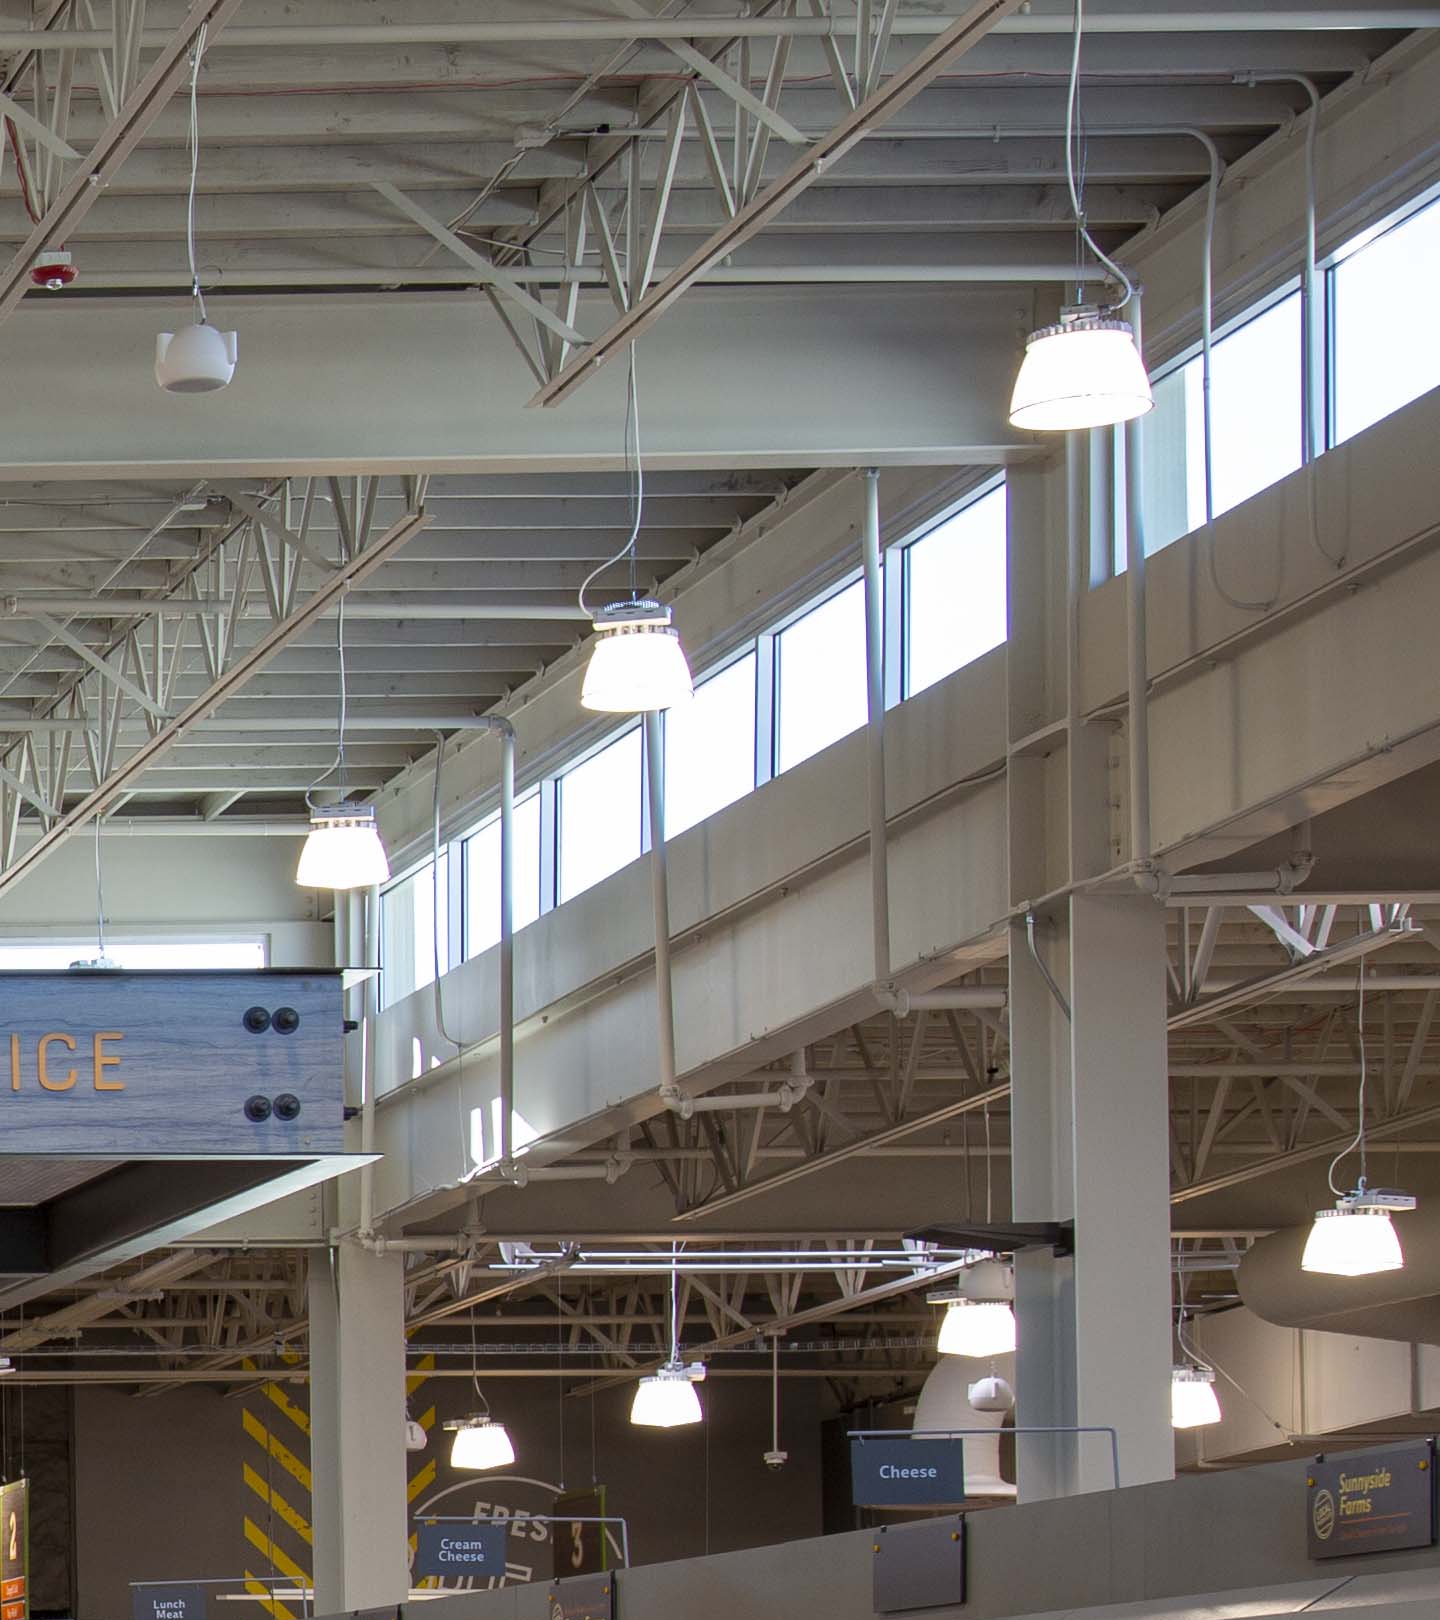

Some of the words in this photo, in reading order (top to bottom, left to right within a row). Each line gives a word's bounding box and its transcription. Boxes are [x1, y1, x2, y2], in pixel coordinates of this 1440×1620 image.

[879, 1463, 938, 1482] Cheese
[1339, 1470, 1391, 1493] Sunnyside
[1340, 1497, 1371, 1515] Farms
[441, 1539, 482, 1550] Cream
[438, 1551, 484, 1562] Cheese
[153, 1600, 185, 1609] Lunch
[156, 1610, 184, 1619] Meat
